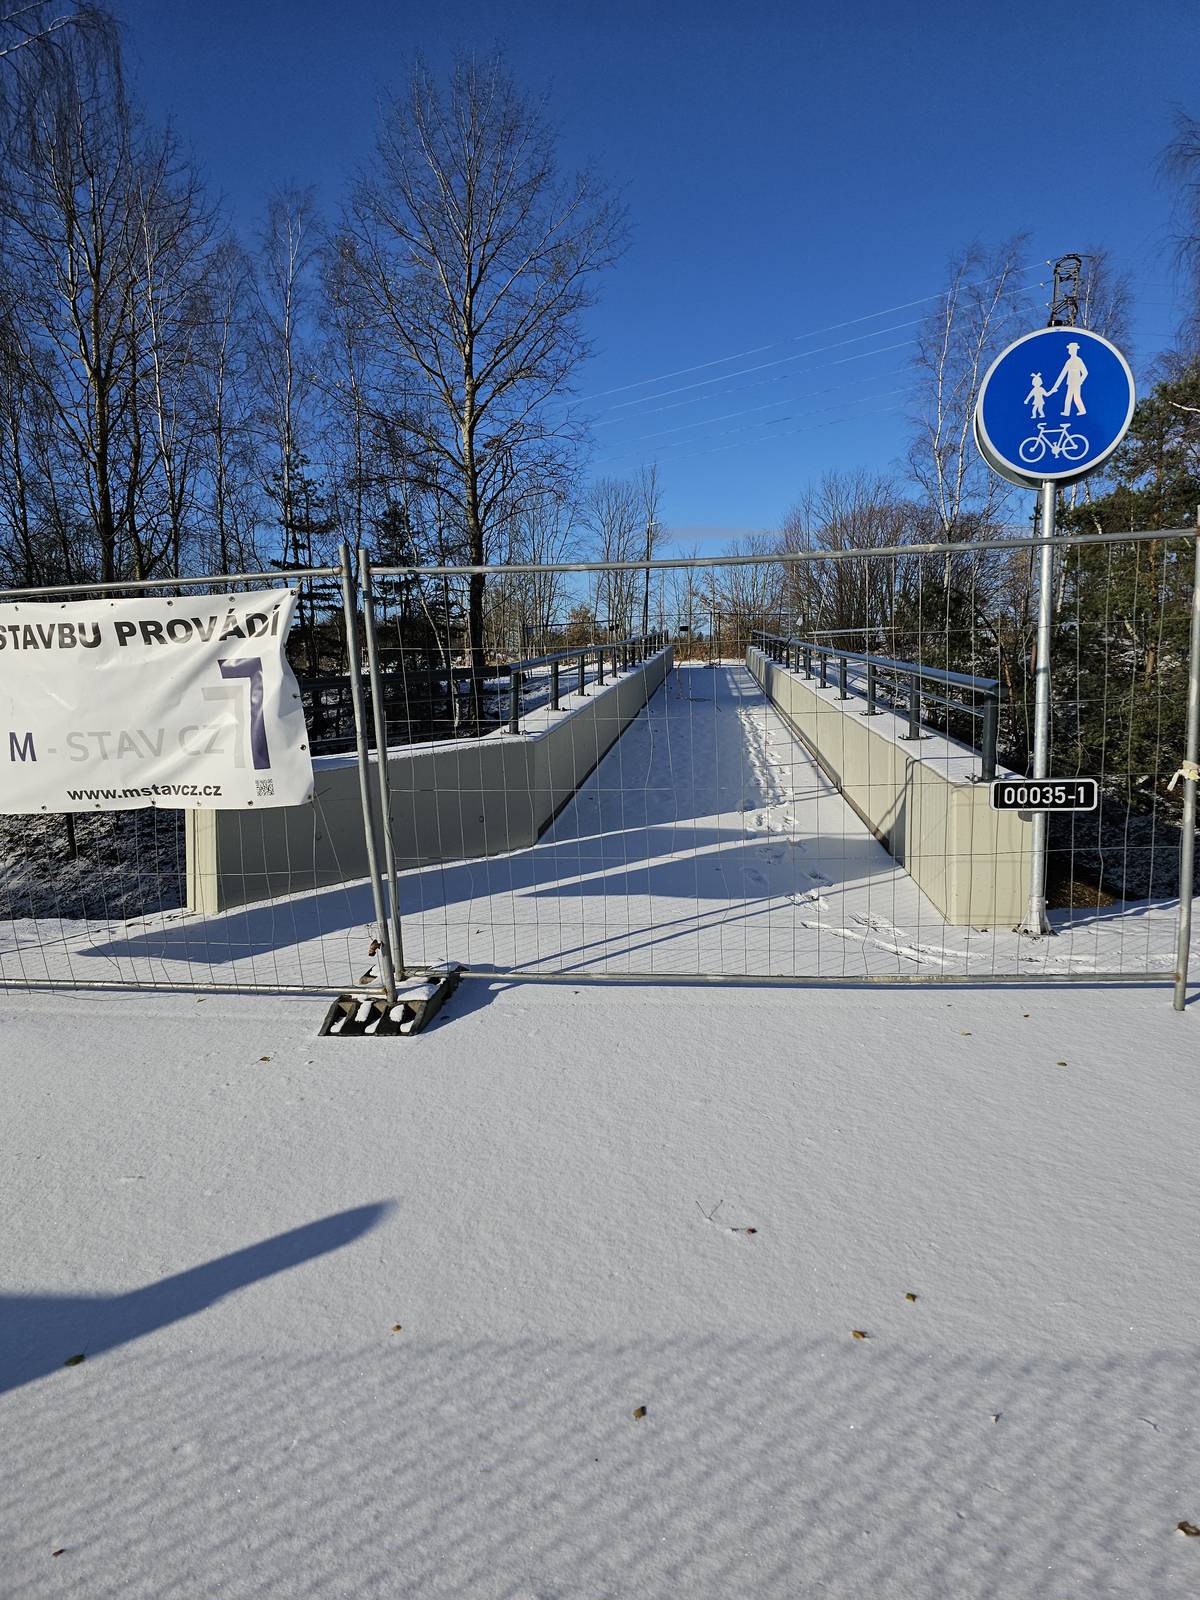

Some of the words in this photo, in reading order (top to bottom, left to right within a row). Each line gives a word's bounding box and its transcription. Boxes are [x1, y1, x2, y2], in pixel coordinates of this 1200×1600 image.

[114, 604, 281, 646] PROVÁDÍ
[9, 731, 37, 762] M
[66, 727, 165, 762] STAV
[178, 722, 225, 756] CZ
[67, 783, 222, 801] www.mstavcz.cz
[1004, 786, 1085, 804] 00035-1
